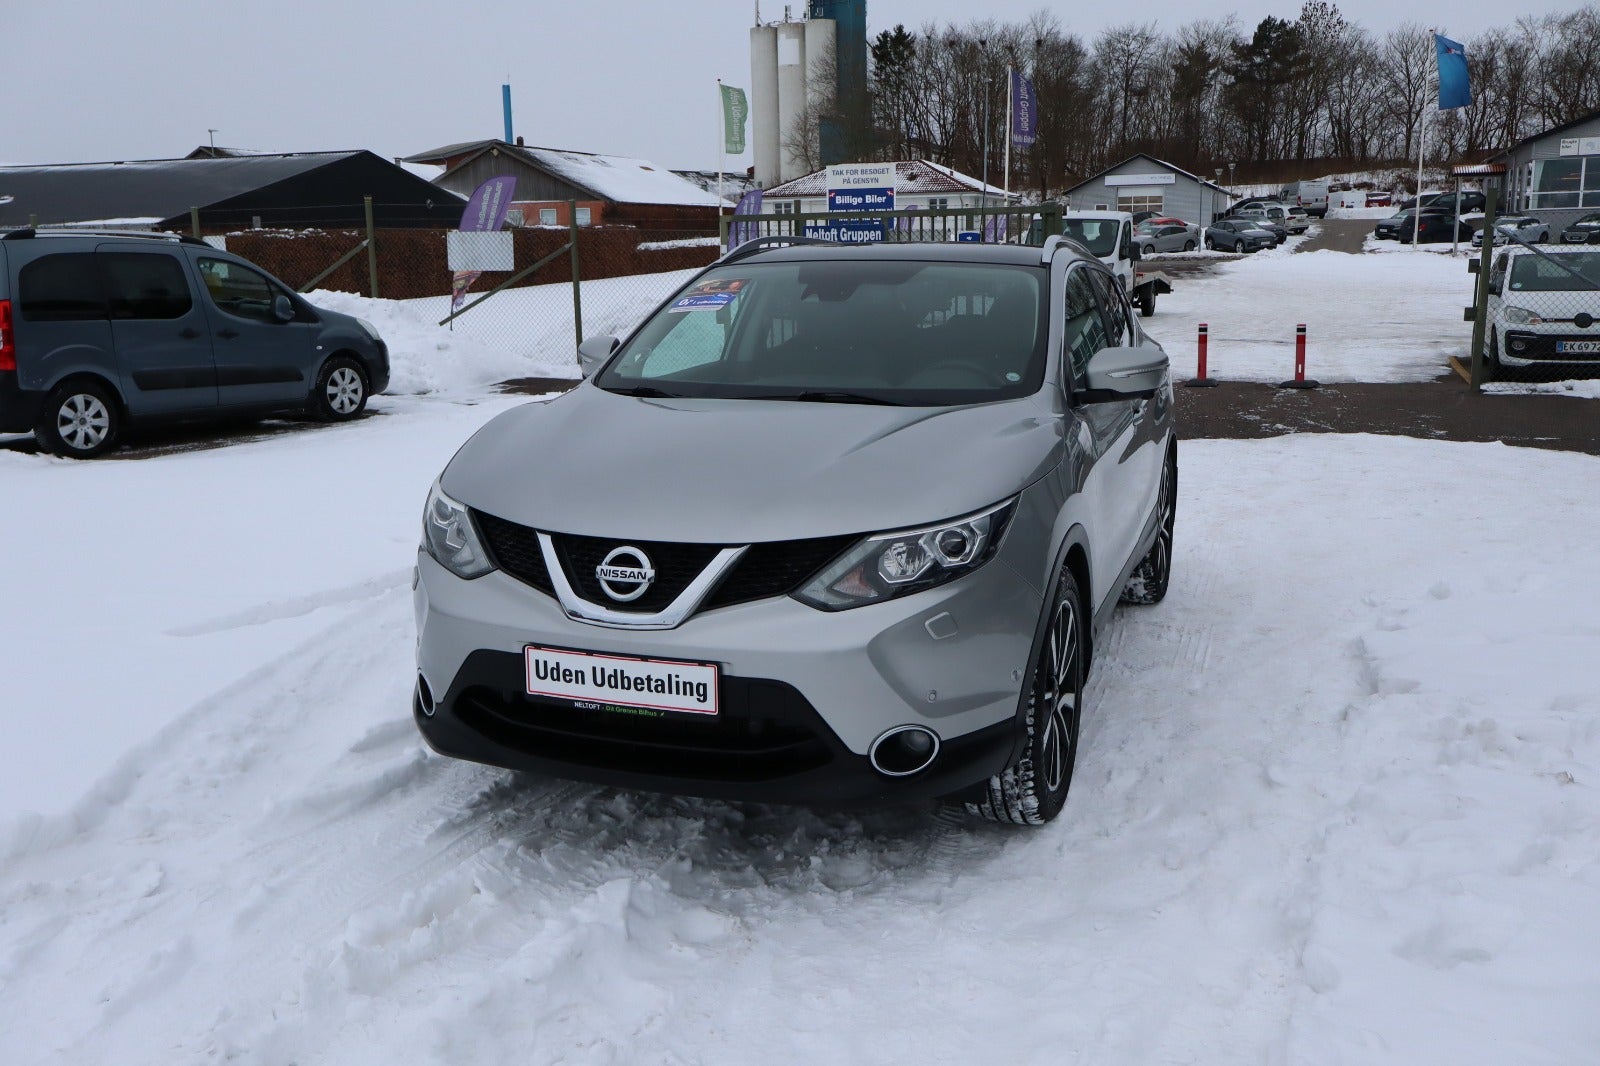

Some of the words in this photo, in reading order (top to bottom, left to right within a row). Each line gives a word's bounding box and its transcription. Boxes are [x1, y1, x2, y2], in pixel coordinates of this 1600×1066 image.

[1020, 101, 1029, 131] Gruppen
[835, 195, 863, 205] Billige
[865, 194, 887, 203] Biler
[805, 227, 838, 242] Neltoft
[839, 227, 882, 243] Gruppen
[1563, 342, 1576, 351] EK
[1577, 342, 1590, 351] 69
[600, 568, 647, 581] NISSAN
[534, 658, 586, 686] Uden
[592, 665, 708, 703] Udbetaling
[574, 701, 600, 710] NELTOFT
